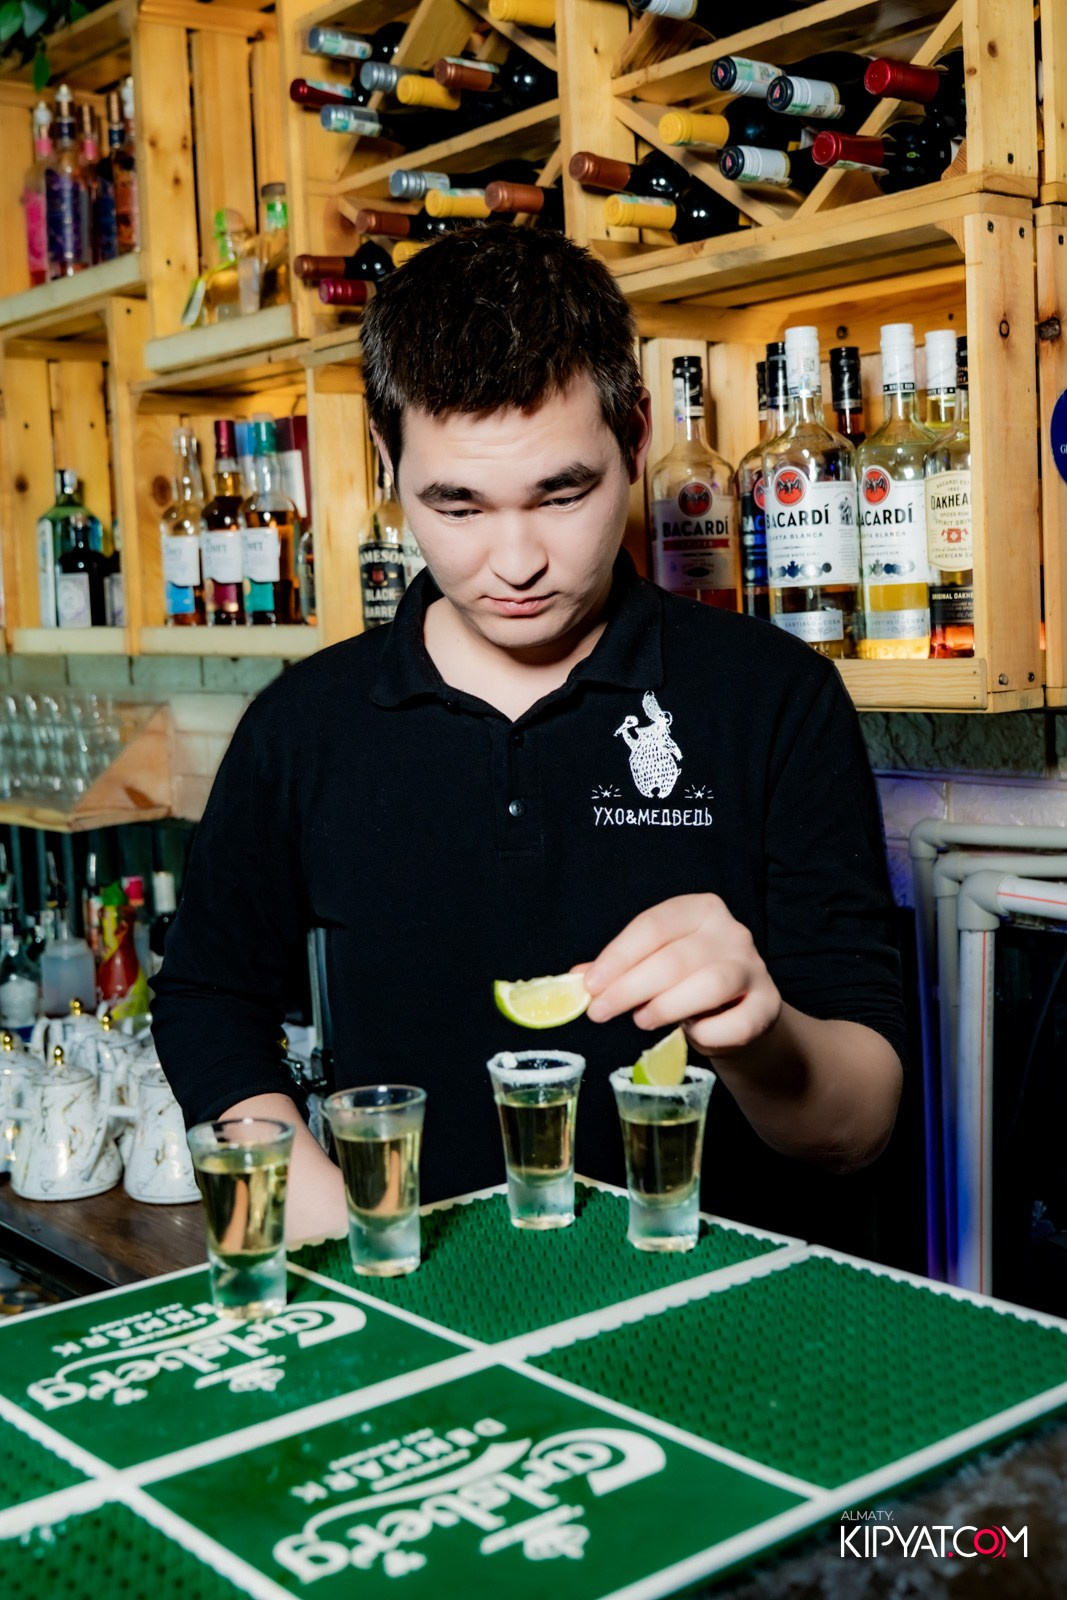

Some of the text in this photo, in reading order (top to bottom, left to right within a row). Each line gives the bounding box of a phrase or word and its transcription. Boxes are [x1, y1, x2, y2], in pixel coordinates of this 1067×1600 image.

[930, 492, 971, 511] OAKHEA
[857, 502, 914, 527] ACARDÍ
[662, 515, 729, 538] BACARDÍ
[789, 531, 824, 541] BLANCA
[875, 531, 907, 539] BLANCA
[364, 605, 398, 619] BARRE
[593, 806, 713, 827] УХО&МЕДВЕДЬ
[51, 1302, 217, 1357] ENMARK
[27, 1301, 367, 1411] Carlsberg
[289, 1418, 507, 1504] DENMARK
[272, 1428, 667, 1585] Carlsberg
